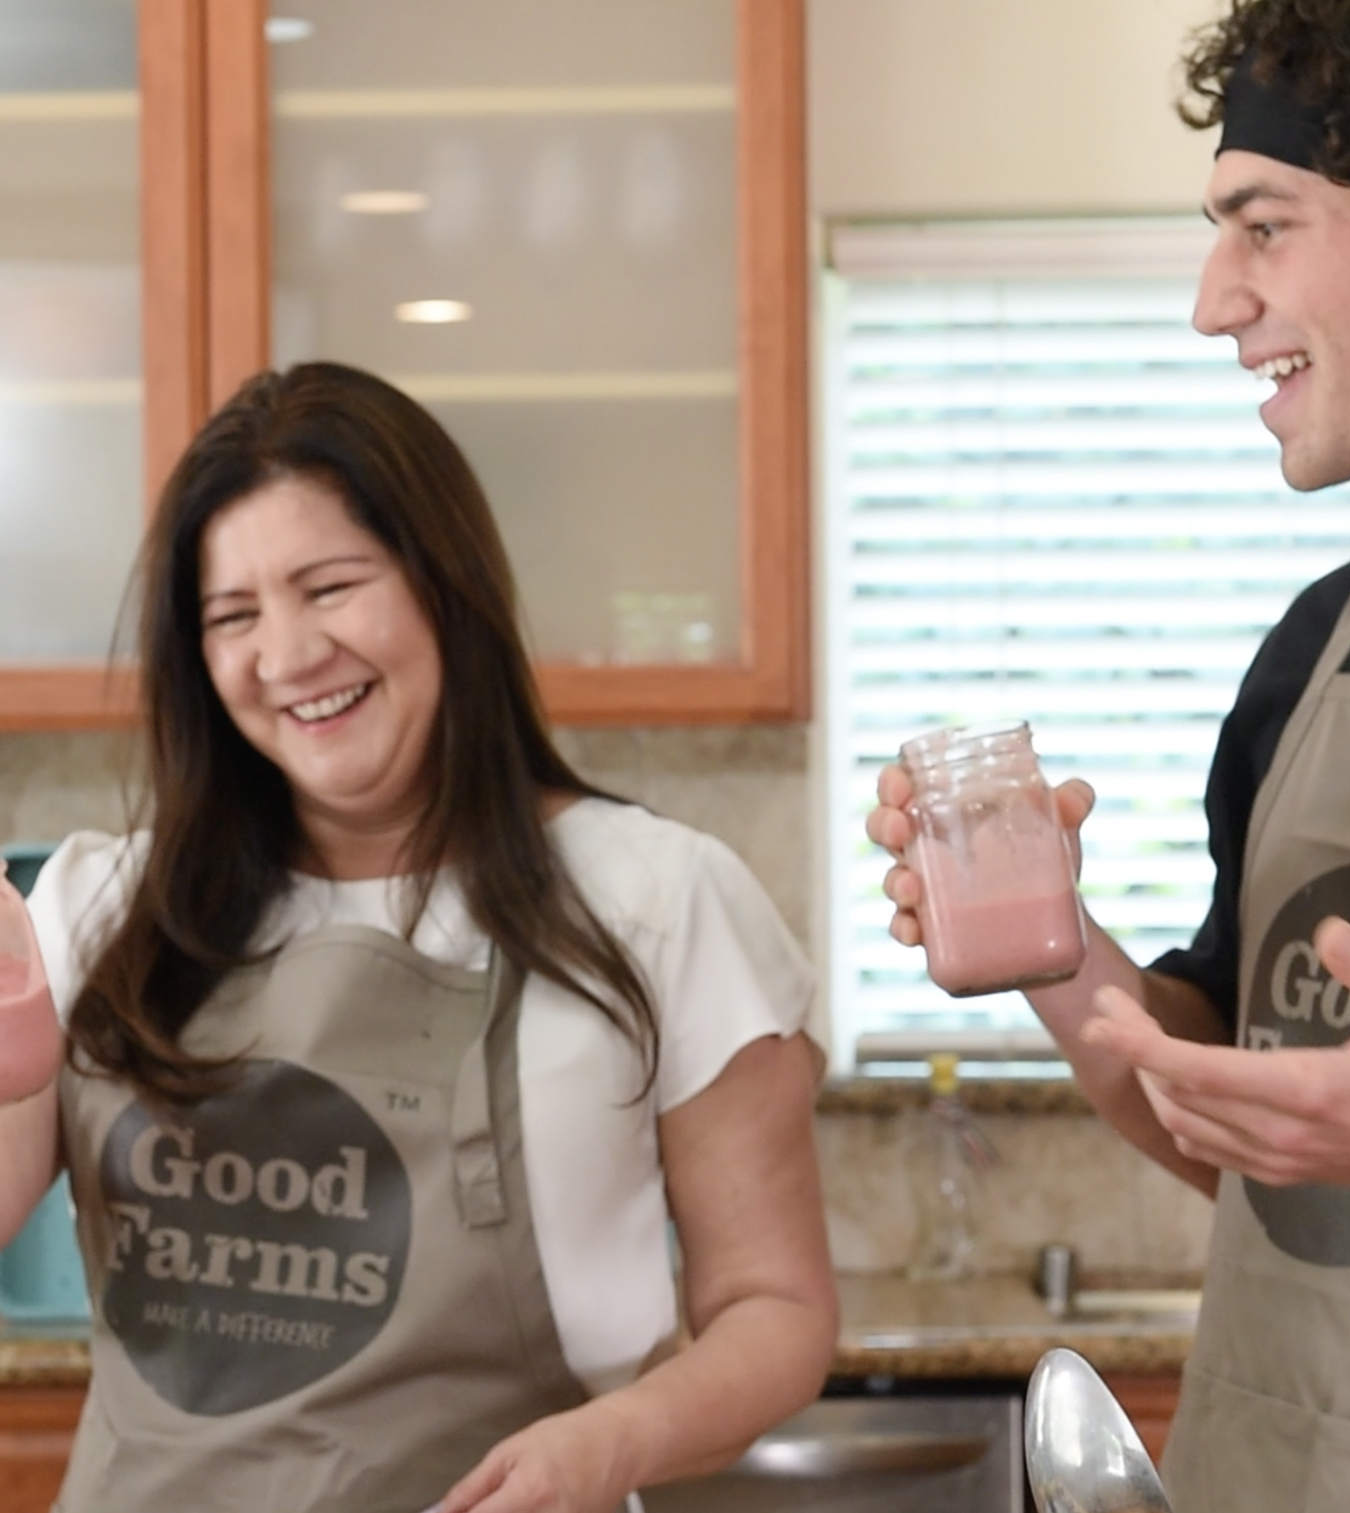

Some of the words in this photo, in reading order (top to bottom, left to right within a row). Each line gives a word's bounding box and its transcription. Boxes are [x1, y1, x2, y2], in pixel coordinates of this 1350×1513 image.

[386, 1090, 421, 1112] TM
[129, 1125, 370, 1221] Good
[103, 1203, 390, 1308] Farms
